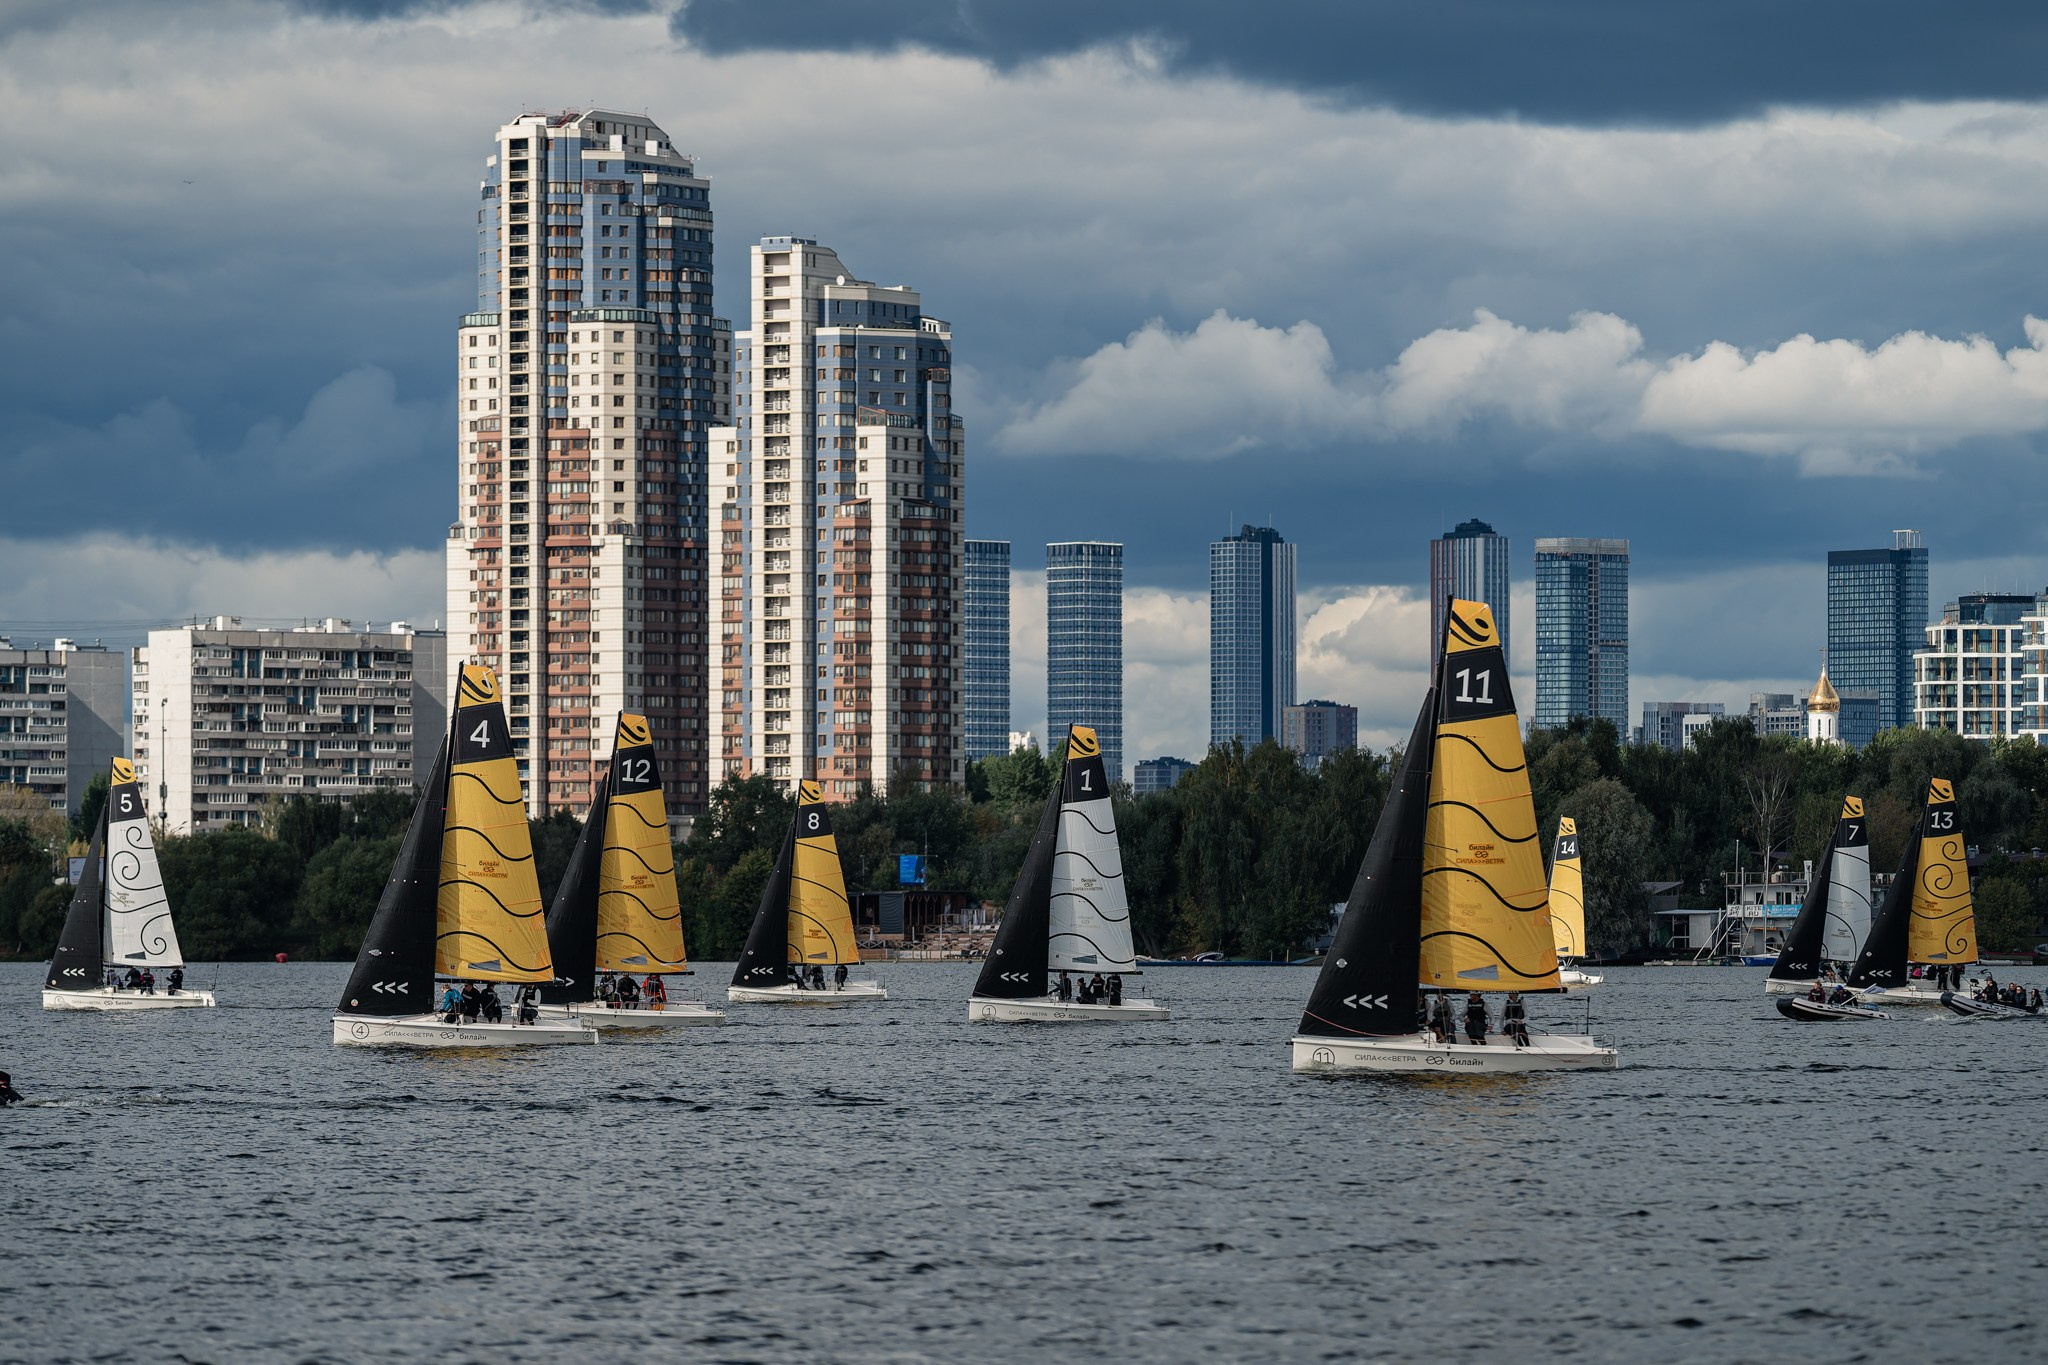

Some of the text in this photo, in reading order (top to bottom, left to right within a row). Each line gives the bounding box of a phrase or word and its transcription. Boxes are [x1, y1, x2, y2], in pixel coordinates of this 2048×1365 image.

[1455, 667, 1494, 704] 11
[469, 719, 491, 749] 4
[621, 758, 651, 783] 12
[1080, 769, 1093, 792] 1
[120, 793, 133, 813] 5
[808, 812, 820, 830] 8
[1930, 811, 1954, 829] 13
[1848, 824, 1859, 841] 7
[1469, 843, 1495, 851] билайн
[1560, 841, 1576, 855] 14
[459, 1033, 487, 1041] билайн
[1449, 1057, 1484, 1067] билайн
